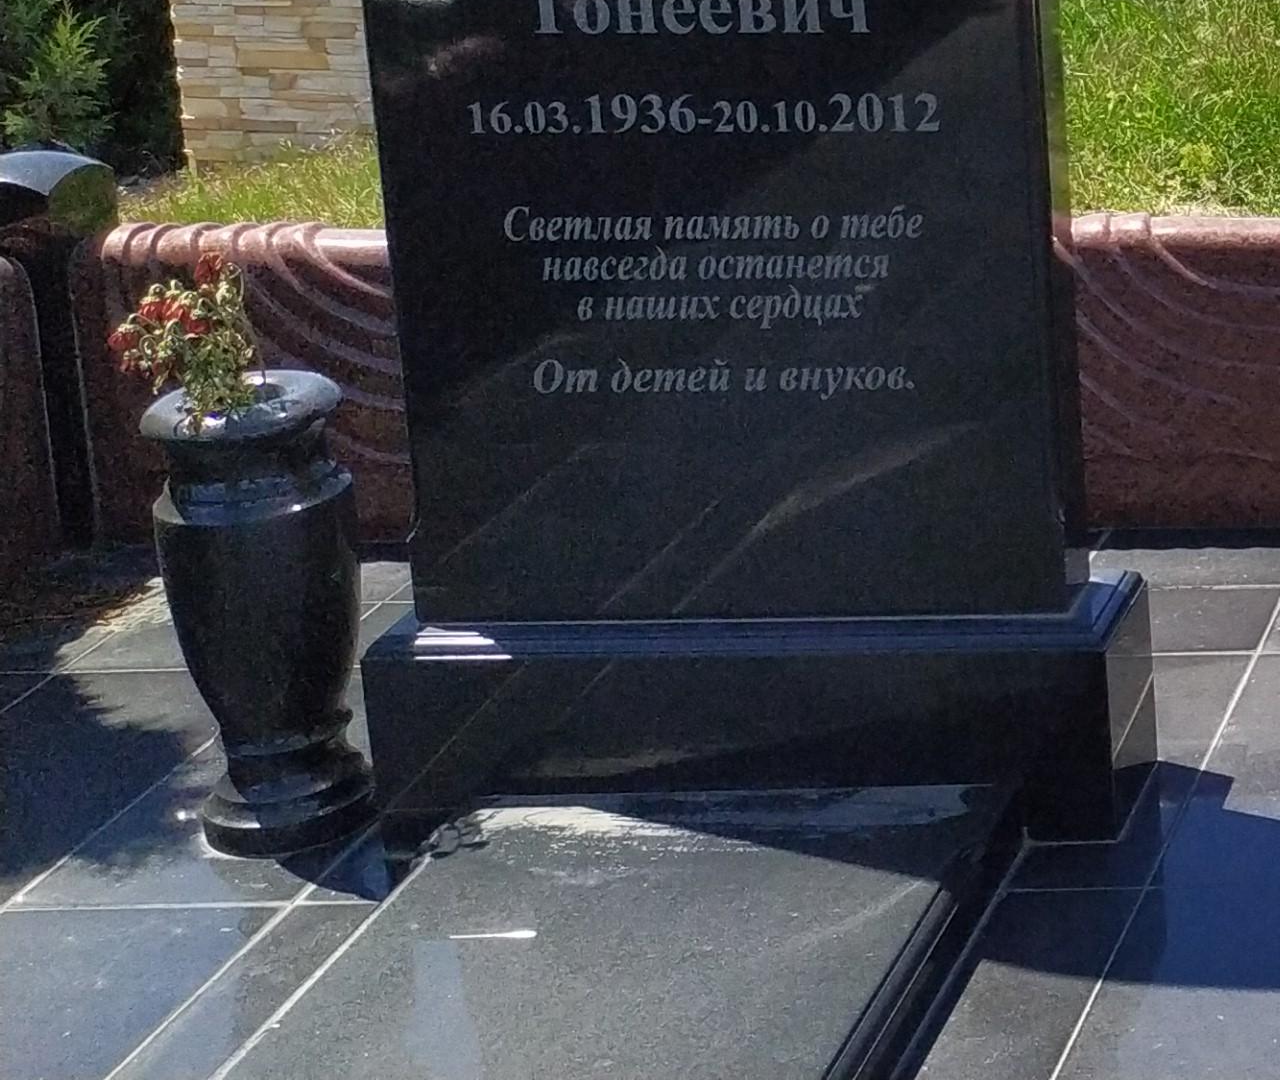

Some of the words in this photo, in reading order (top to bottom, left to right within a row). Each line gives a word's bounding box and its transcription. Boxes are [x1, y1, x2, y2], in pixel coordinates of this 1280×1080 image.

[468, 93, 941, 135] 16.03.1936-20.10.2012
[503, 206, 653, 242] Светлая
[664, 215, 801, 241] память
[810, 216, 829, 239] о
[840, 206, 923, 239] тебе
[542, 246, 687, 281] навсегда
[697, 253, 890, 280] останется
[577, 298, 592, 321] в
[605, 295, 720, 320] наших
[730, 285, 864, 329] сердцах
[533, 359, 598, 394] От
[611, 359, 731, 393] детей
[744, 368, 768, 391] и
[780, 365, 915, 400] внуков.
